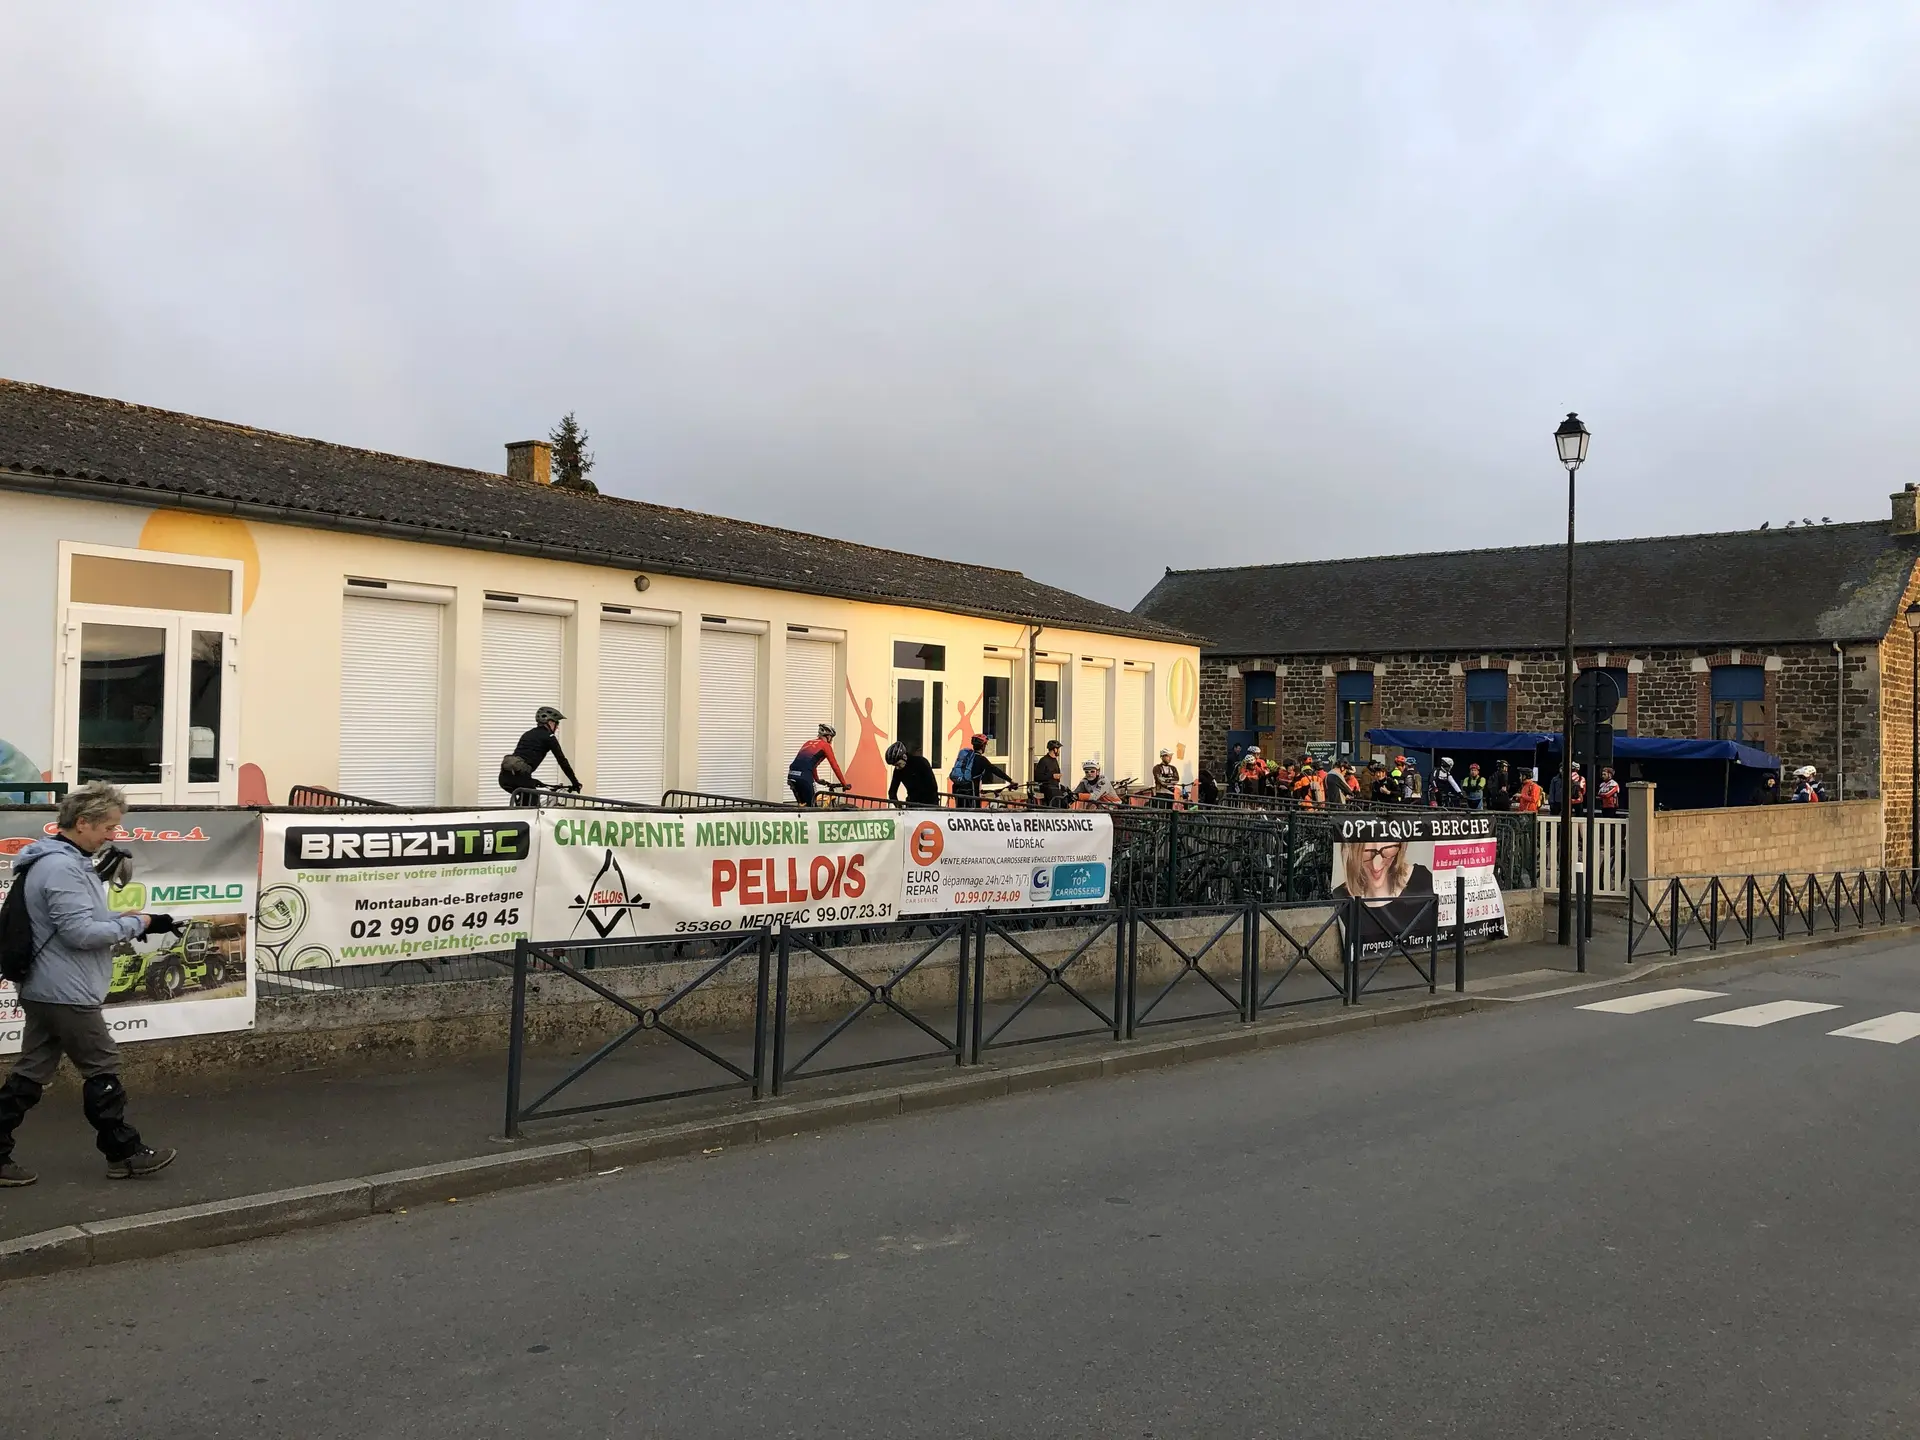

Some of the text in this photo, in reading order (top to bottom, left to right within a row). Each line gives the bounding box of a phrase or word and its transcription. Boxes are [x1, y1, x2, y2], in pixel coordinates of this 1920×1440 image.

[948, 818, 1094, 832] GARAGE de la RENAISSANCE
[1342, 818, 1490, 839] OPTIQUE BERCHE
[554, 819, 892, 847] CHARPENTE MENUISERIE ESCALIERS
[1006, 838, 1046, 849] MÉDRÉAC
[1076, 854, 1098, 862] MARQUES
[297, 872, 331, 883] Pour
[404, 869, 437, 879] votre
[440, 865, 518, 878] informatique
[711, 853, 866, 907] PELLOIS
[907, 870, 941, 883] EURO
[1072, 876, 1087, 886] TOP
[942, 875, 984, 888] dépannage
[151, 883, 243, 901] MERLO
[593, 890, 624, 905] PELLOIS
[906, 885, 939, 896] REPAR
[954, 890, 1021, 904] 02.99.07.34.09
[1055, 886, 1102, 897] CARROSSERIE
[355, 890, 524, 911] Montauban-de-Bretagne
[350, 908, 519, 939] 02 99 06 49 45
[675, 903, 893, 932] 35360 MEDREAC 99.07.23.31
[340, 931, 529, 959] www.breizhtic.com
[1409, 934, 1424, 946] Tiers
